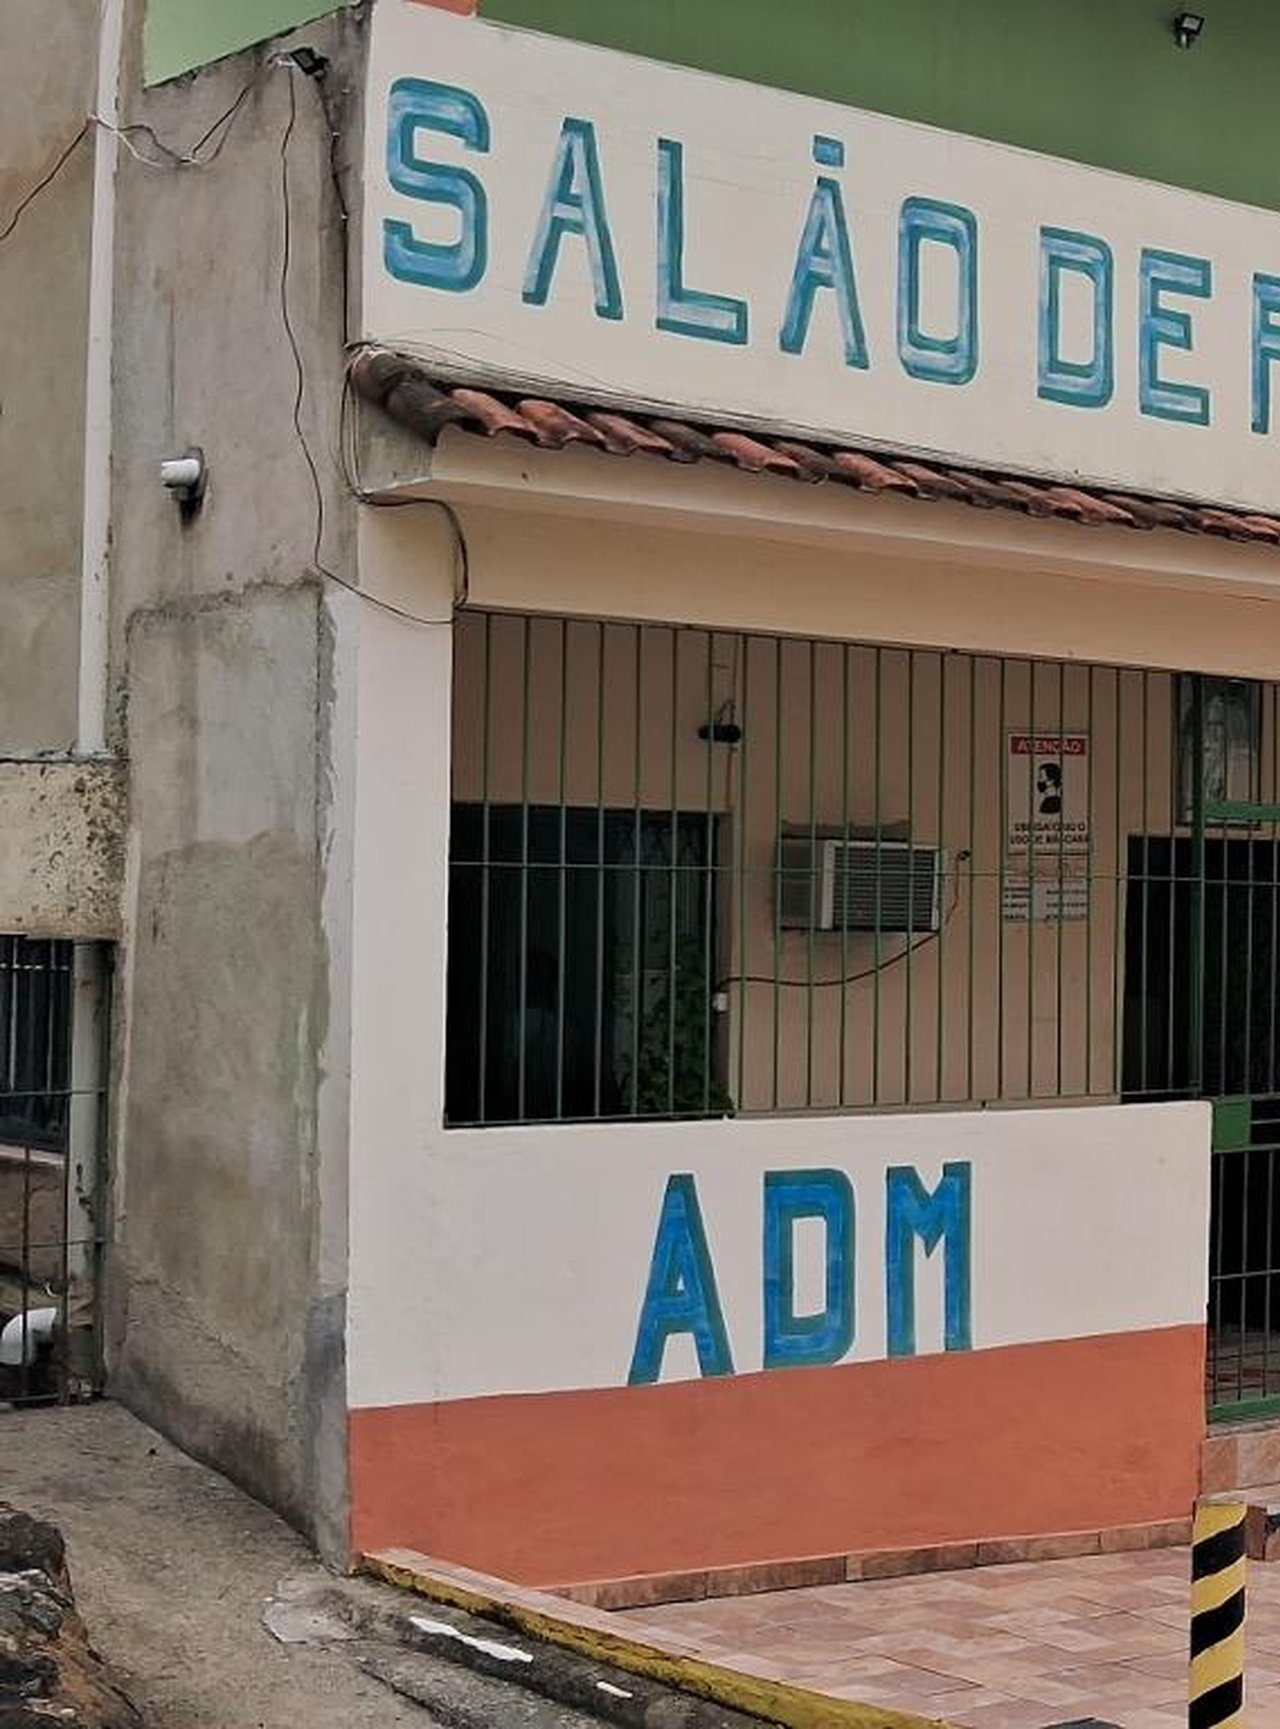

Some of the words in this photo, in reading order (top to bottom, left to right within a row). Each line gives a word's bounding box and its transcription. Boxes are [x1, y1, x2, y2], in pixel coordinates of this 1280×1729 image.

[382, 76, 981, 386] SALÃO
[1037, 224, 1213, 427] DE
[627, 1160, 973, 1387] ADM
